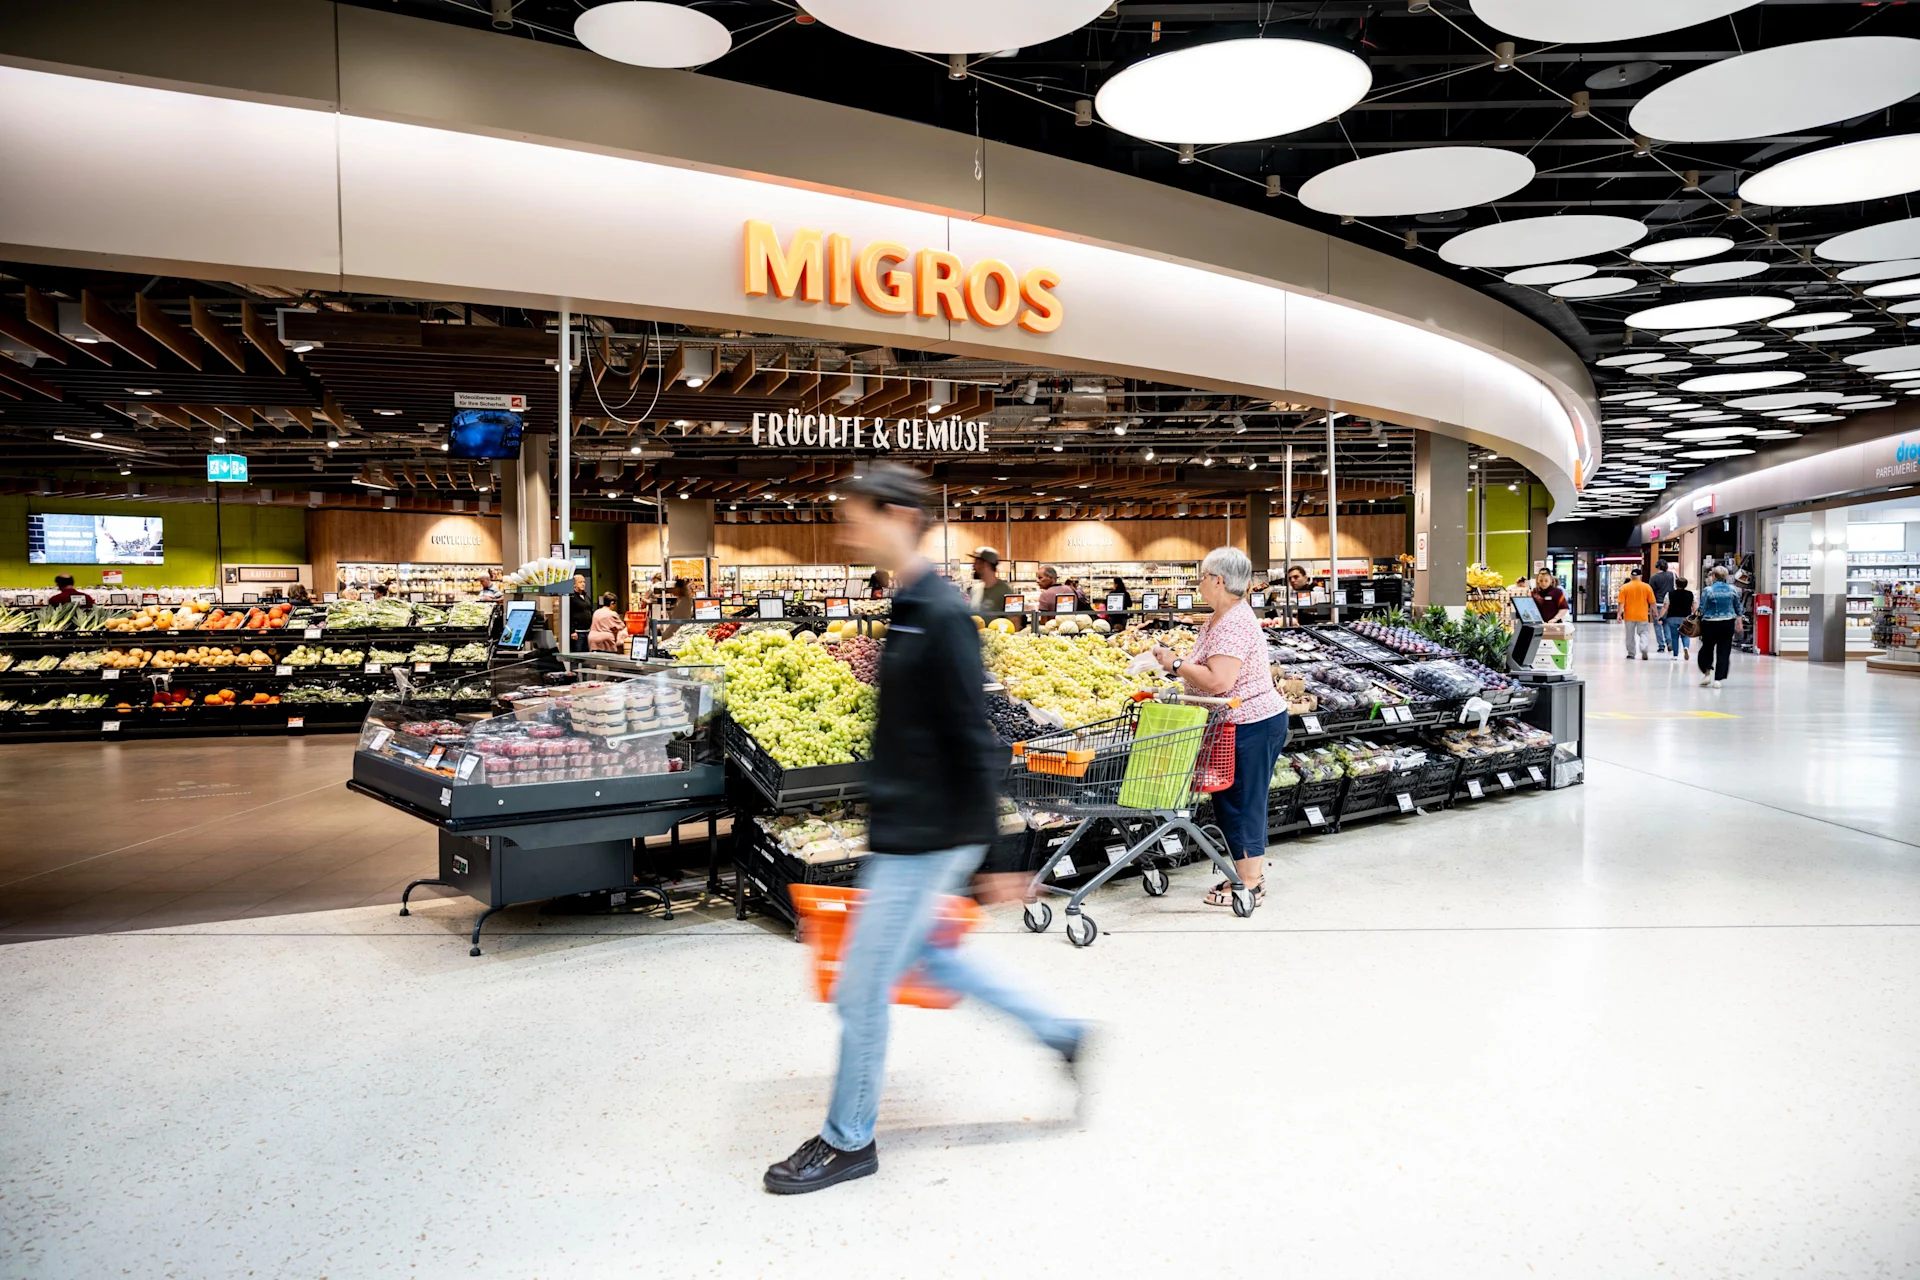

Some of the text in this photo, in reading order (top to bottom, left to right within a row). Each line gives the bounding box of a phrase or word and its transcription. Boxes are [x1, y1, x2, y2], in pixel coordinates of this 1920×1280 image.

[744, 219, 1064, 334] MIGROS
[752, 408, 990, 452] FRÜCHTE & GEMÜSE
[1876, 461, 1918, 478] PARFUMERIE
[431, 535, 481, 546] CONVENIENCE
[250, 570, 272, 578] KAFFEE
